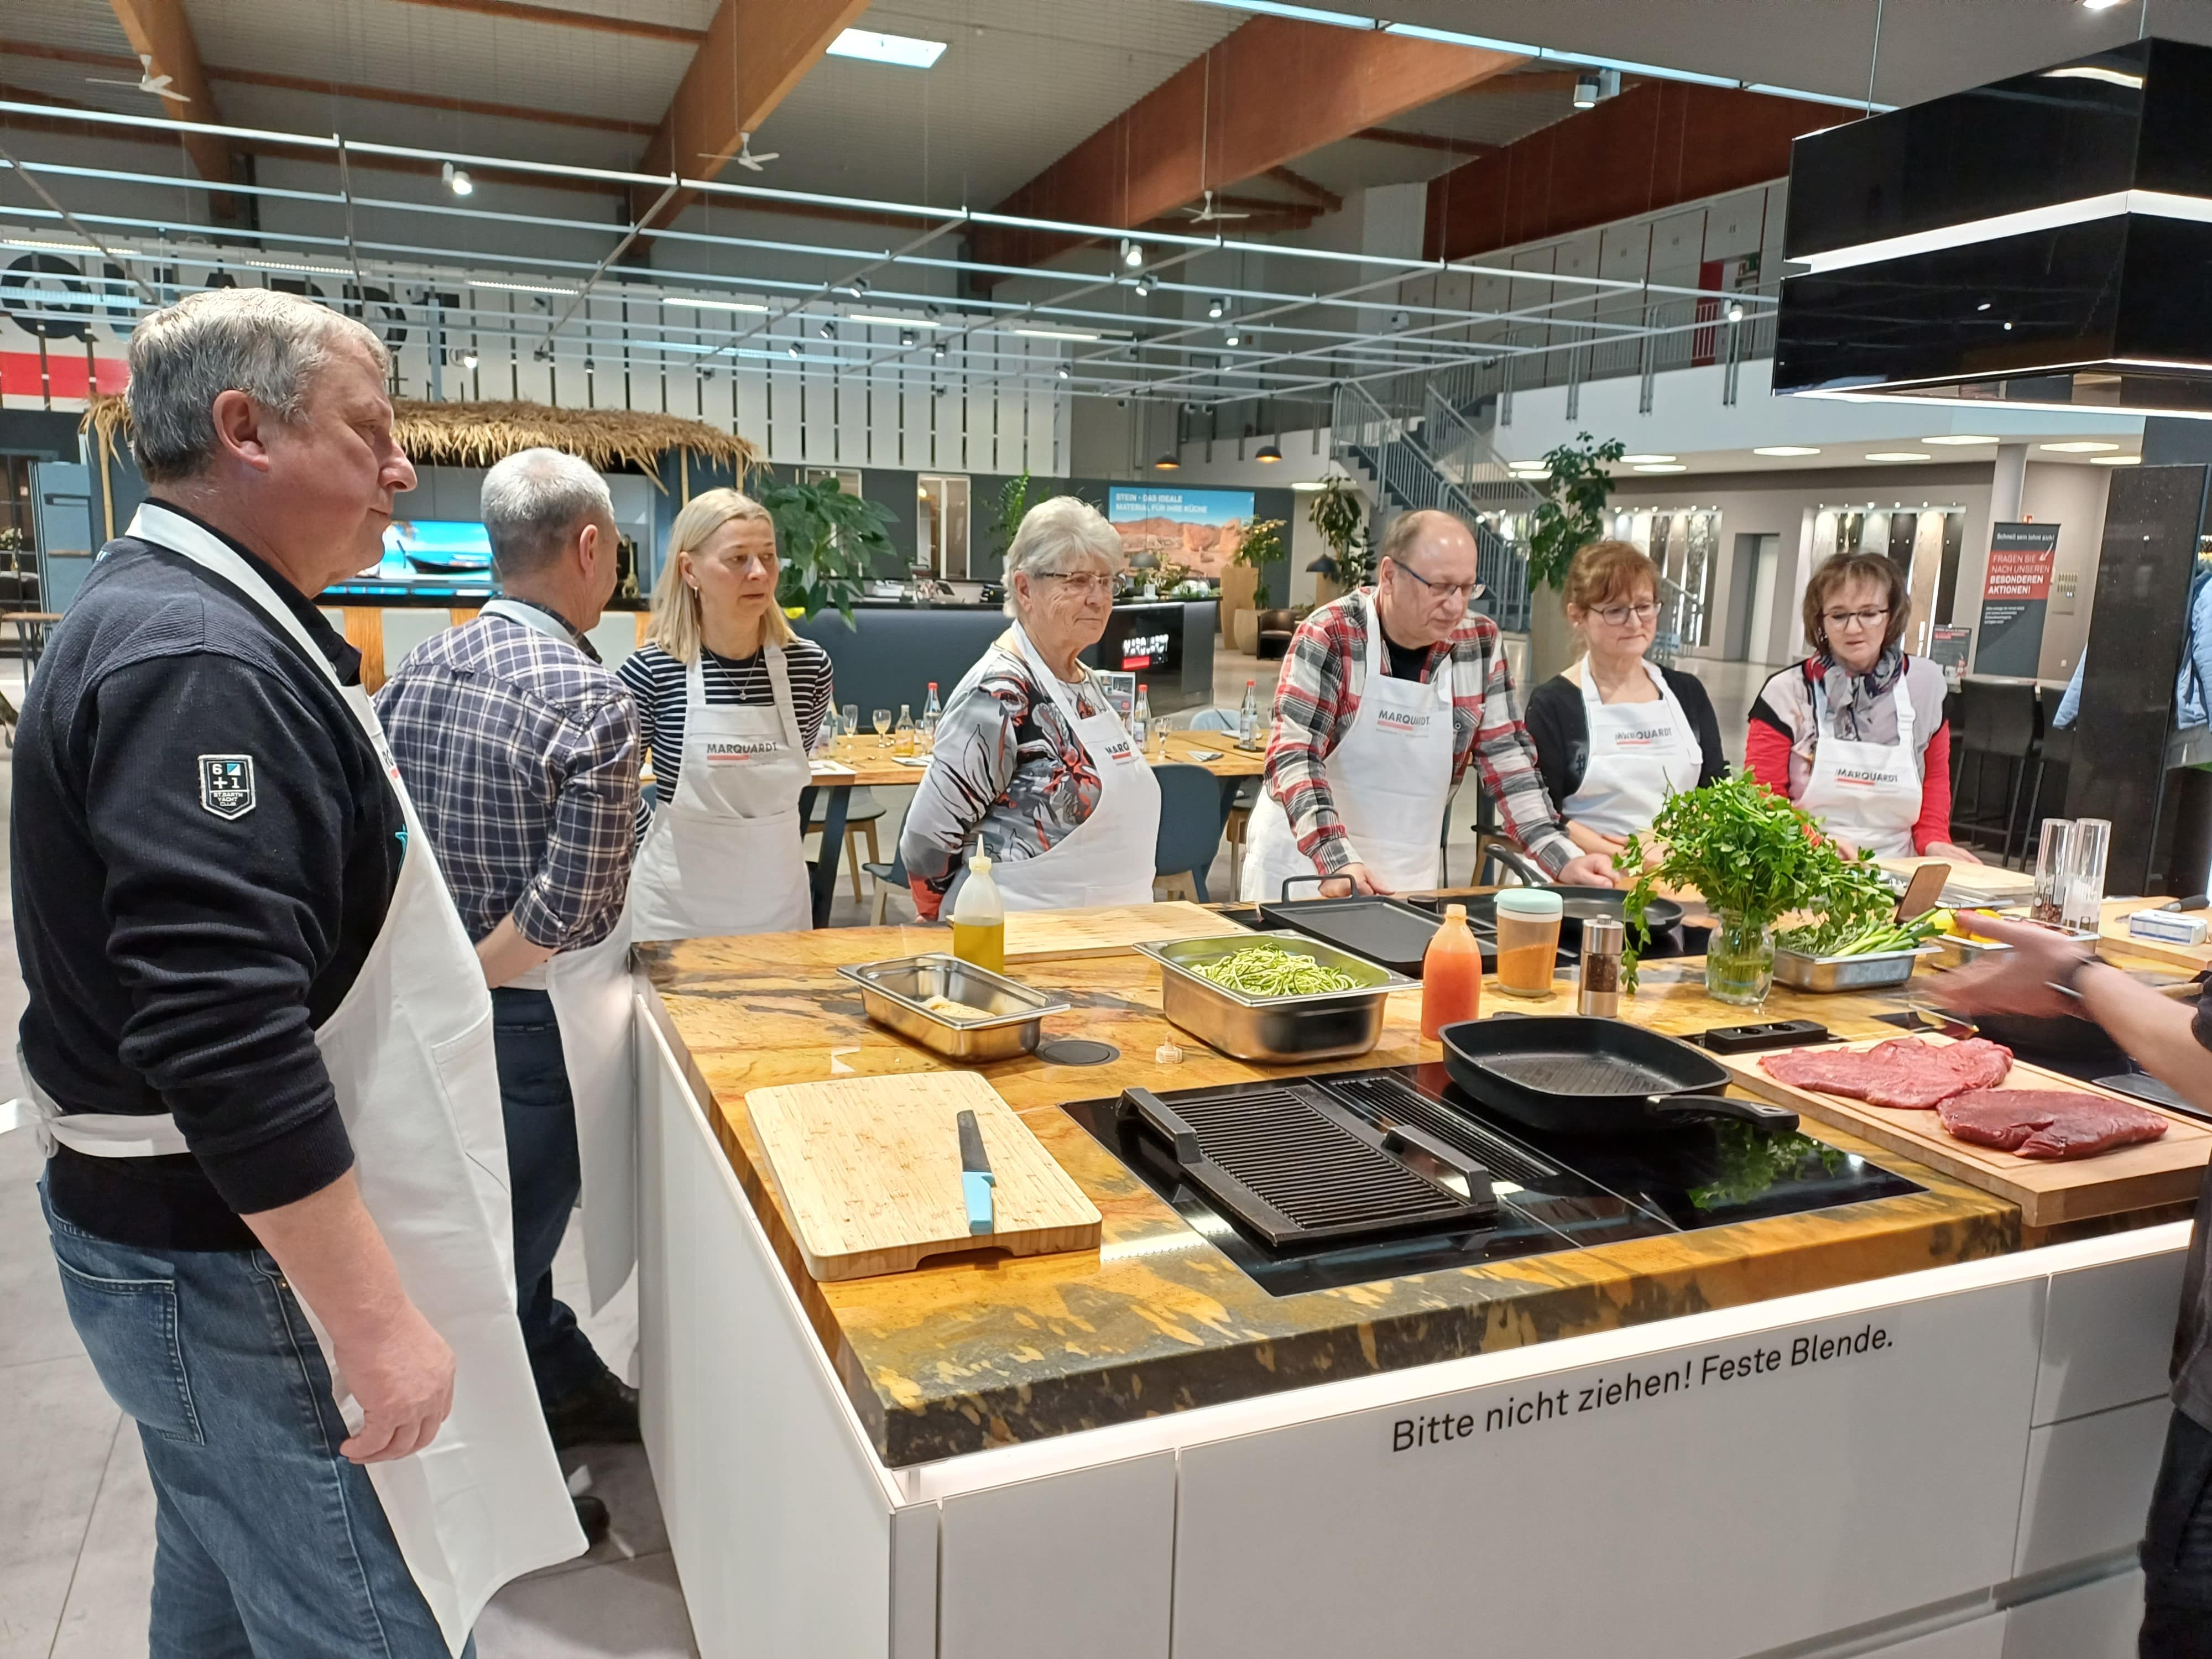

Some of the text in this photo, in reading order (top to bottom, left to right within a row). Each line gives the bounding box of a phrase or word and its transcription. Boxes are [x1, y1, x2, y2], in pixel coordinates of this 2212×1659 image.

[1159, 495, 1182, 503] IDEALE
[1151, 503, 1165, 512] FÜR
[1184, 504, 1207, 513] KÜCHE
[1993, 554, 2036, 563] FRAGEN SIE
[1991, 565, 2050, 573] NACH UNSEREN
[1990, 575, 2044, 584] BESONDEREN
[1988, 585, 2031, 595] AKTIONEN!
[707, 742, 778, 754] MARQUARDT
[212, 764, 223, 775] 6
[1392, 1324, 1893, 1453] Bitte nicht ziehen! Feste Blende.
